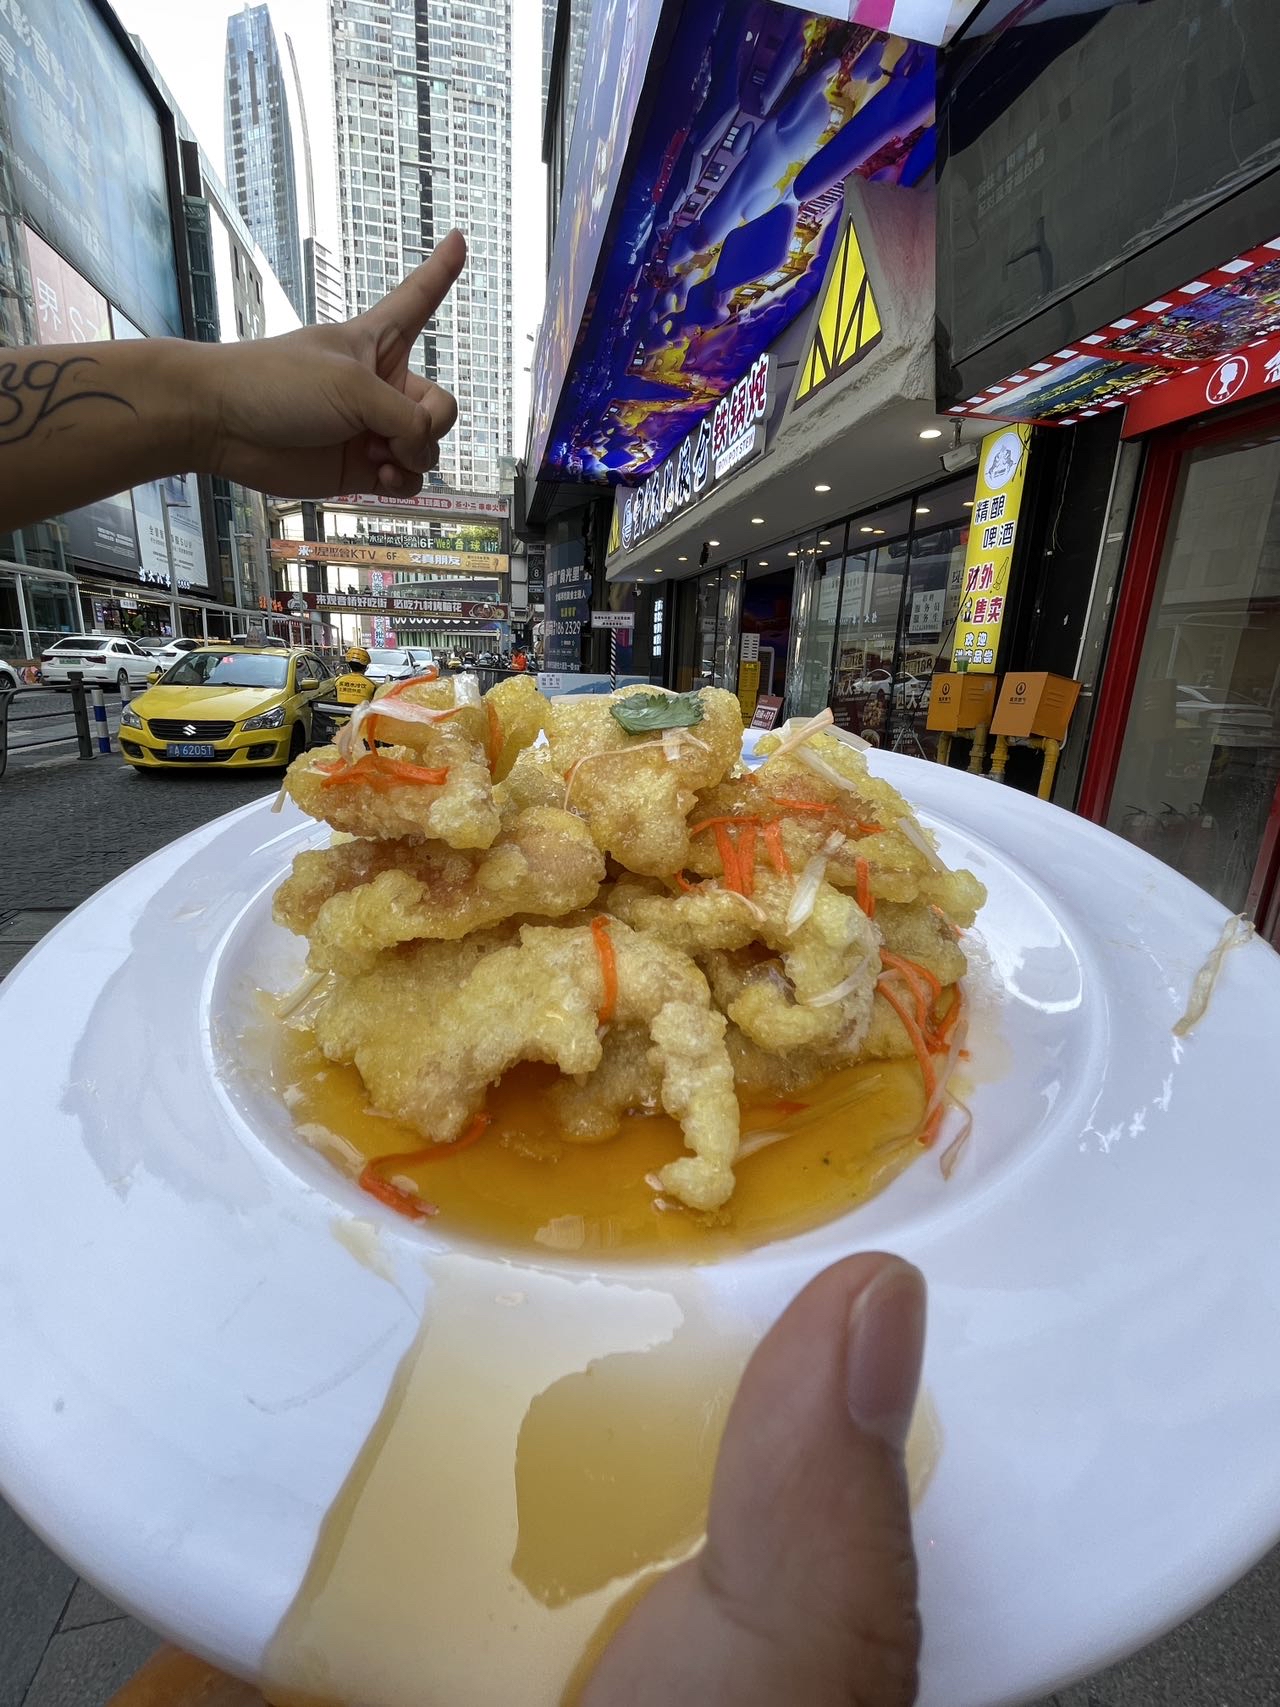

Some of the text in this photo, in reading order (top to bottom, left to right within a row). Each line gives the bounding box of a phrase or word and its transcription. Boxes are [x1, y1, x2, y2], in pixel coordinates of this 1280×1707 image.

[712, 356, 769, 456] 铁锅炖
[973, 494, 1006, 524] 精酿
[420, 538, 434, 549] 6F
[983, 520, 1015, 549] 啤酒
[386, 552, 397, 560] 6F
[455, 540, 480, 551] 台球
[965, 562, 994, 591] 对外
[316, 594, 387, 608] 来观音桥好吃街
[972, 596, 1003, 624] 售卖
[964, 632, 988, 647] 欢迎
